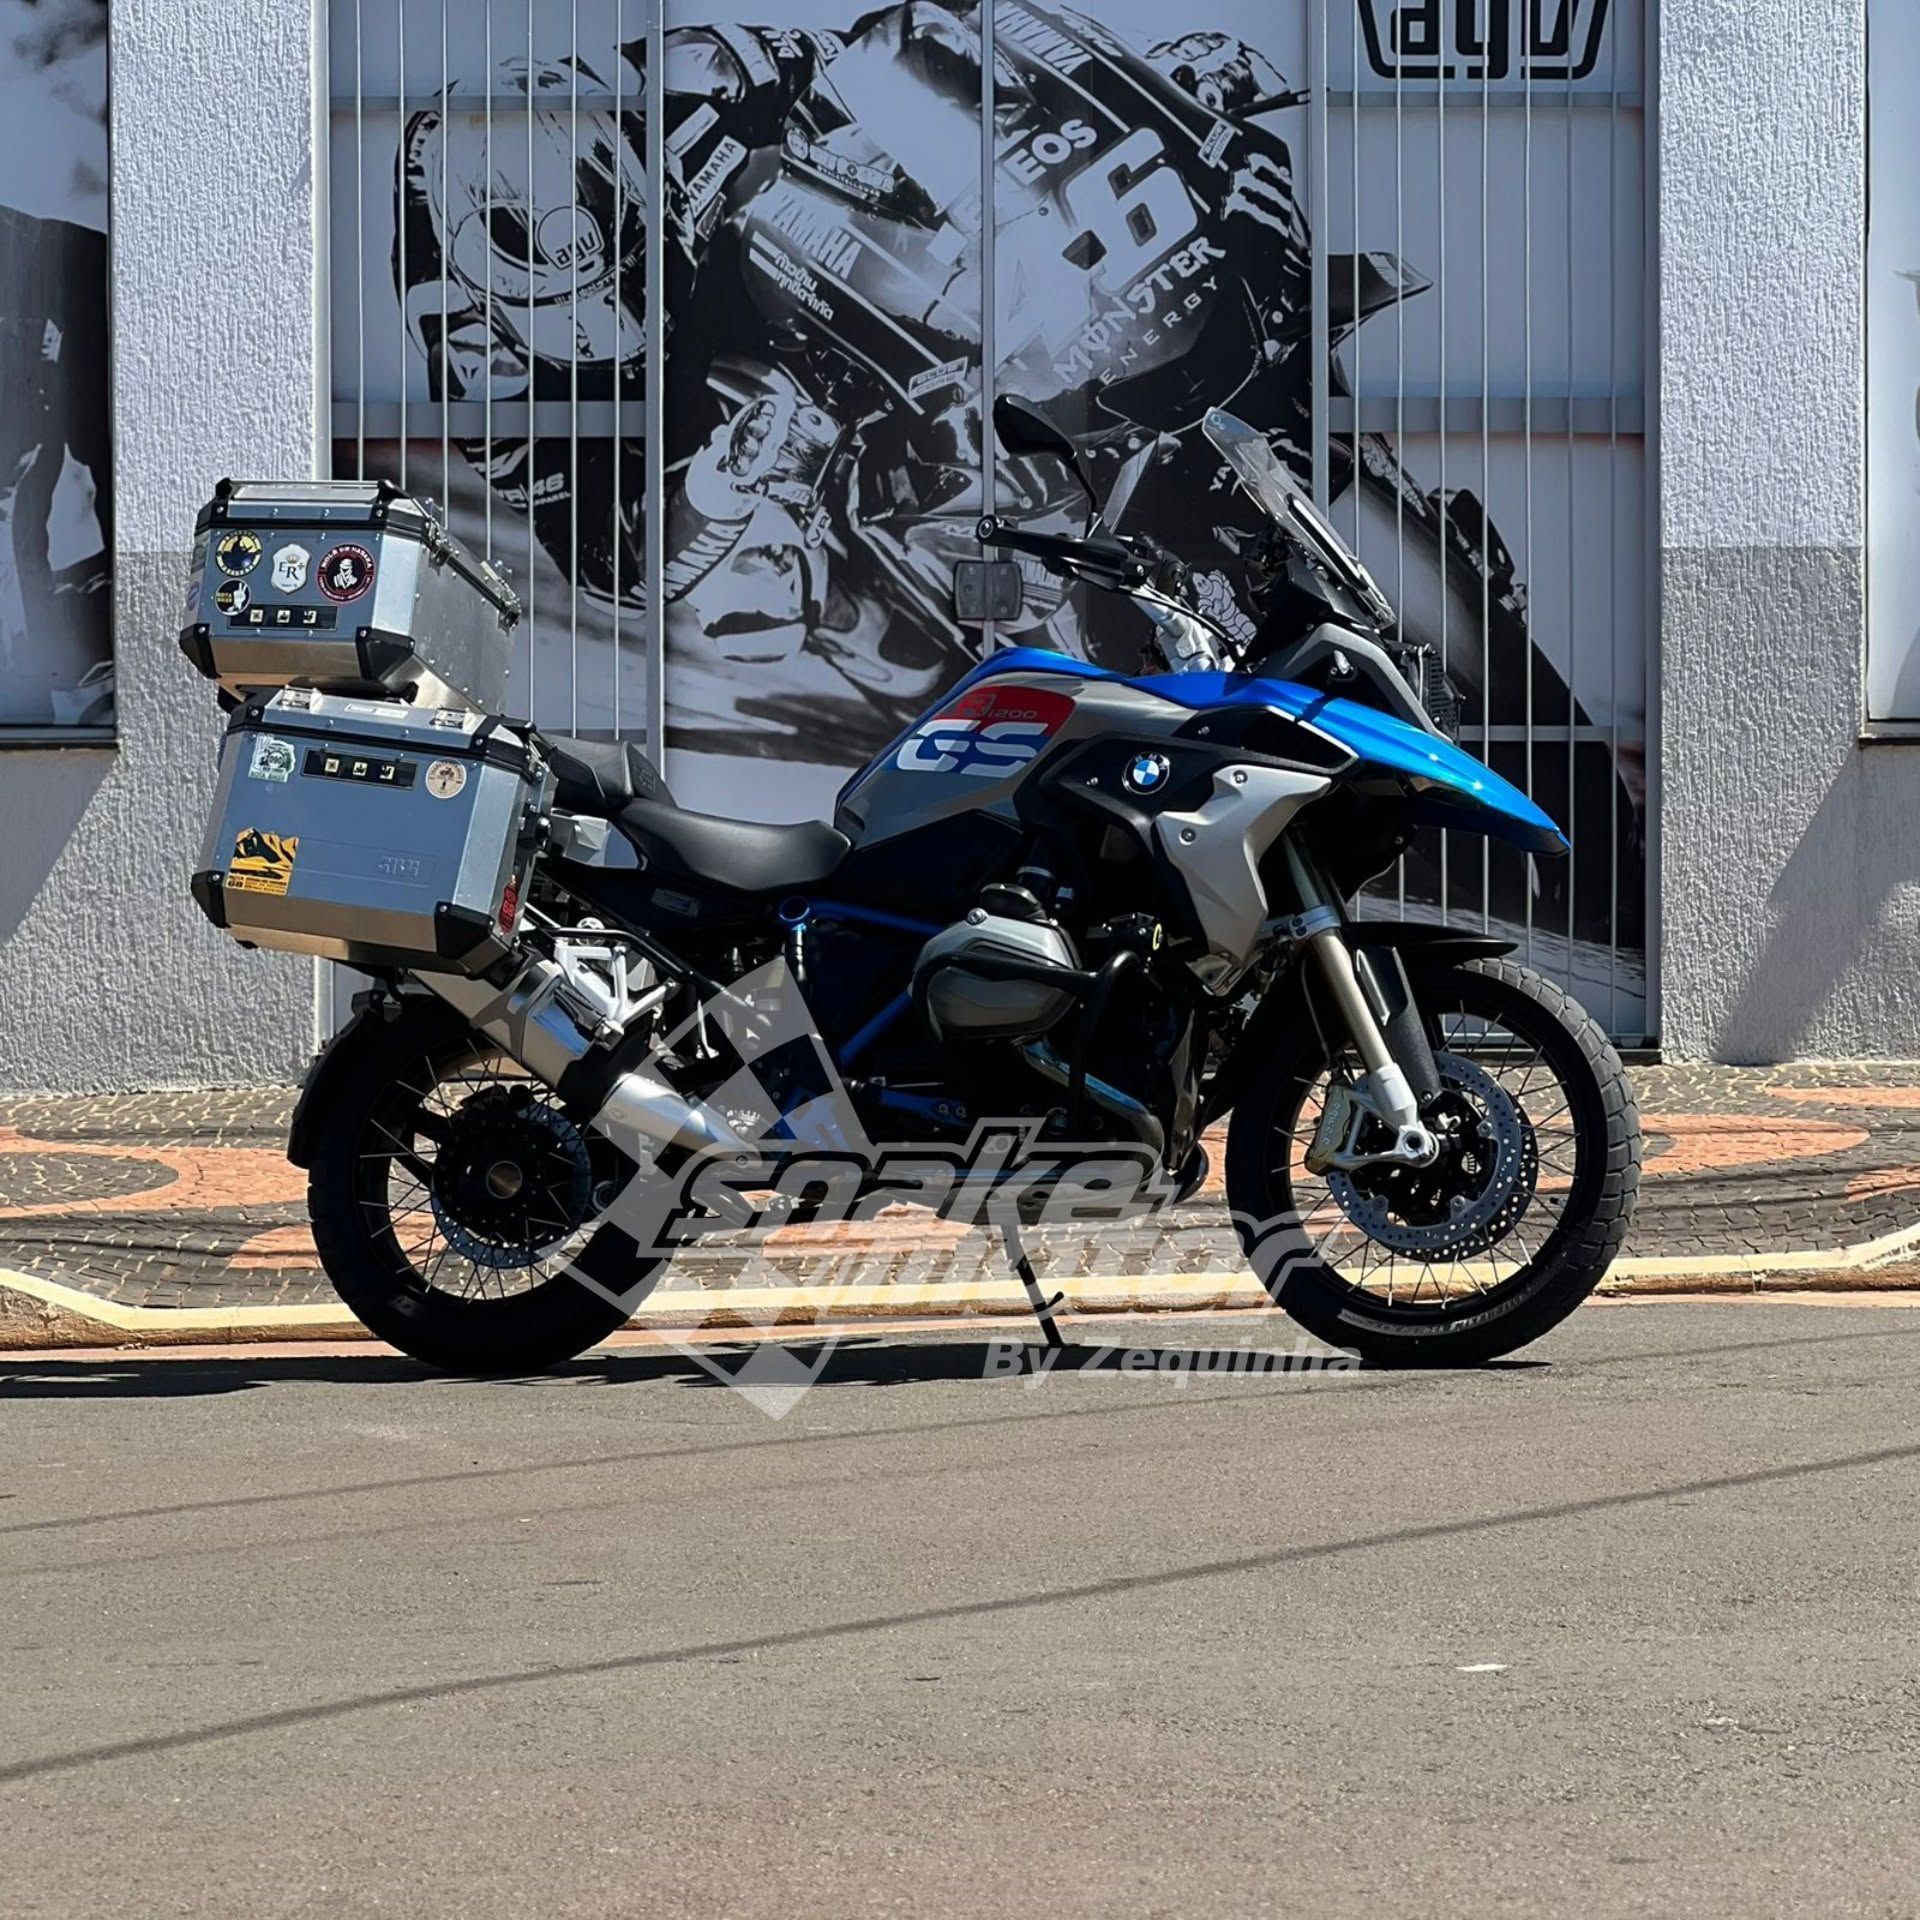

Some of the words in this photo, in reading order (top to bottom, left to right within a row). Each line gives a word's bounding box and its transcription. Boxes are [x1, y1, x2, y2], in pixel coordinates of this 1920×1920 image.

[689, 139, 737, 202] YAMAHA
[556, 231, 595, 265] agv
[1054, 236, 1226, 384] MONSTER
[1100, 276, 1219, 386] ENERGY
[897, 719, 1050, 778] GS
